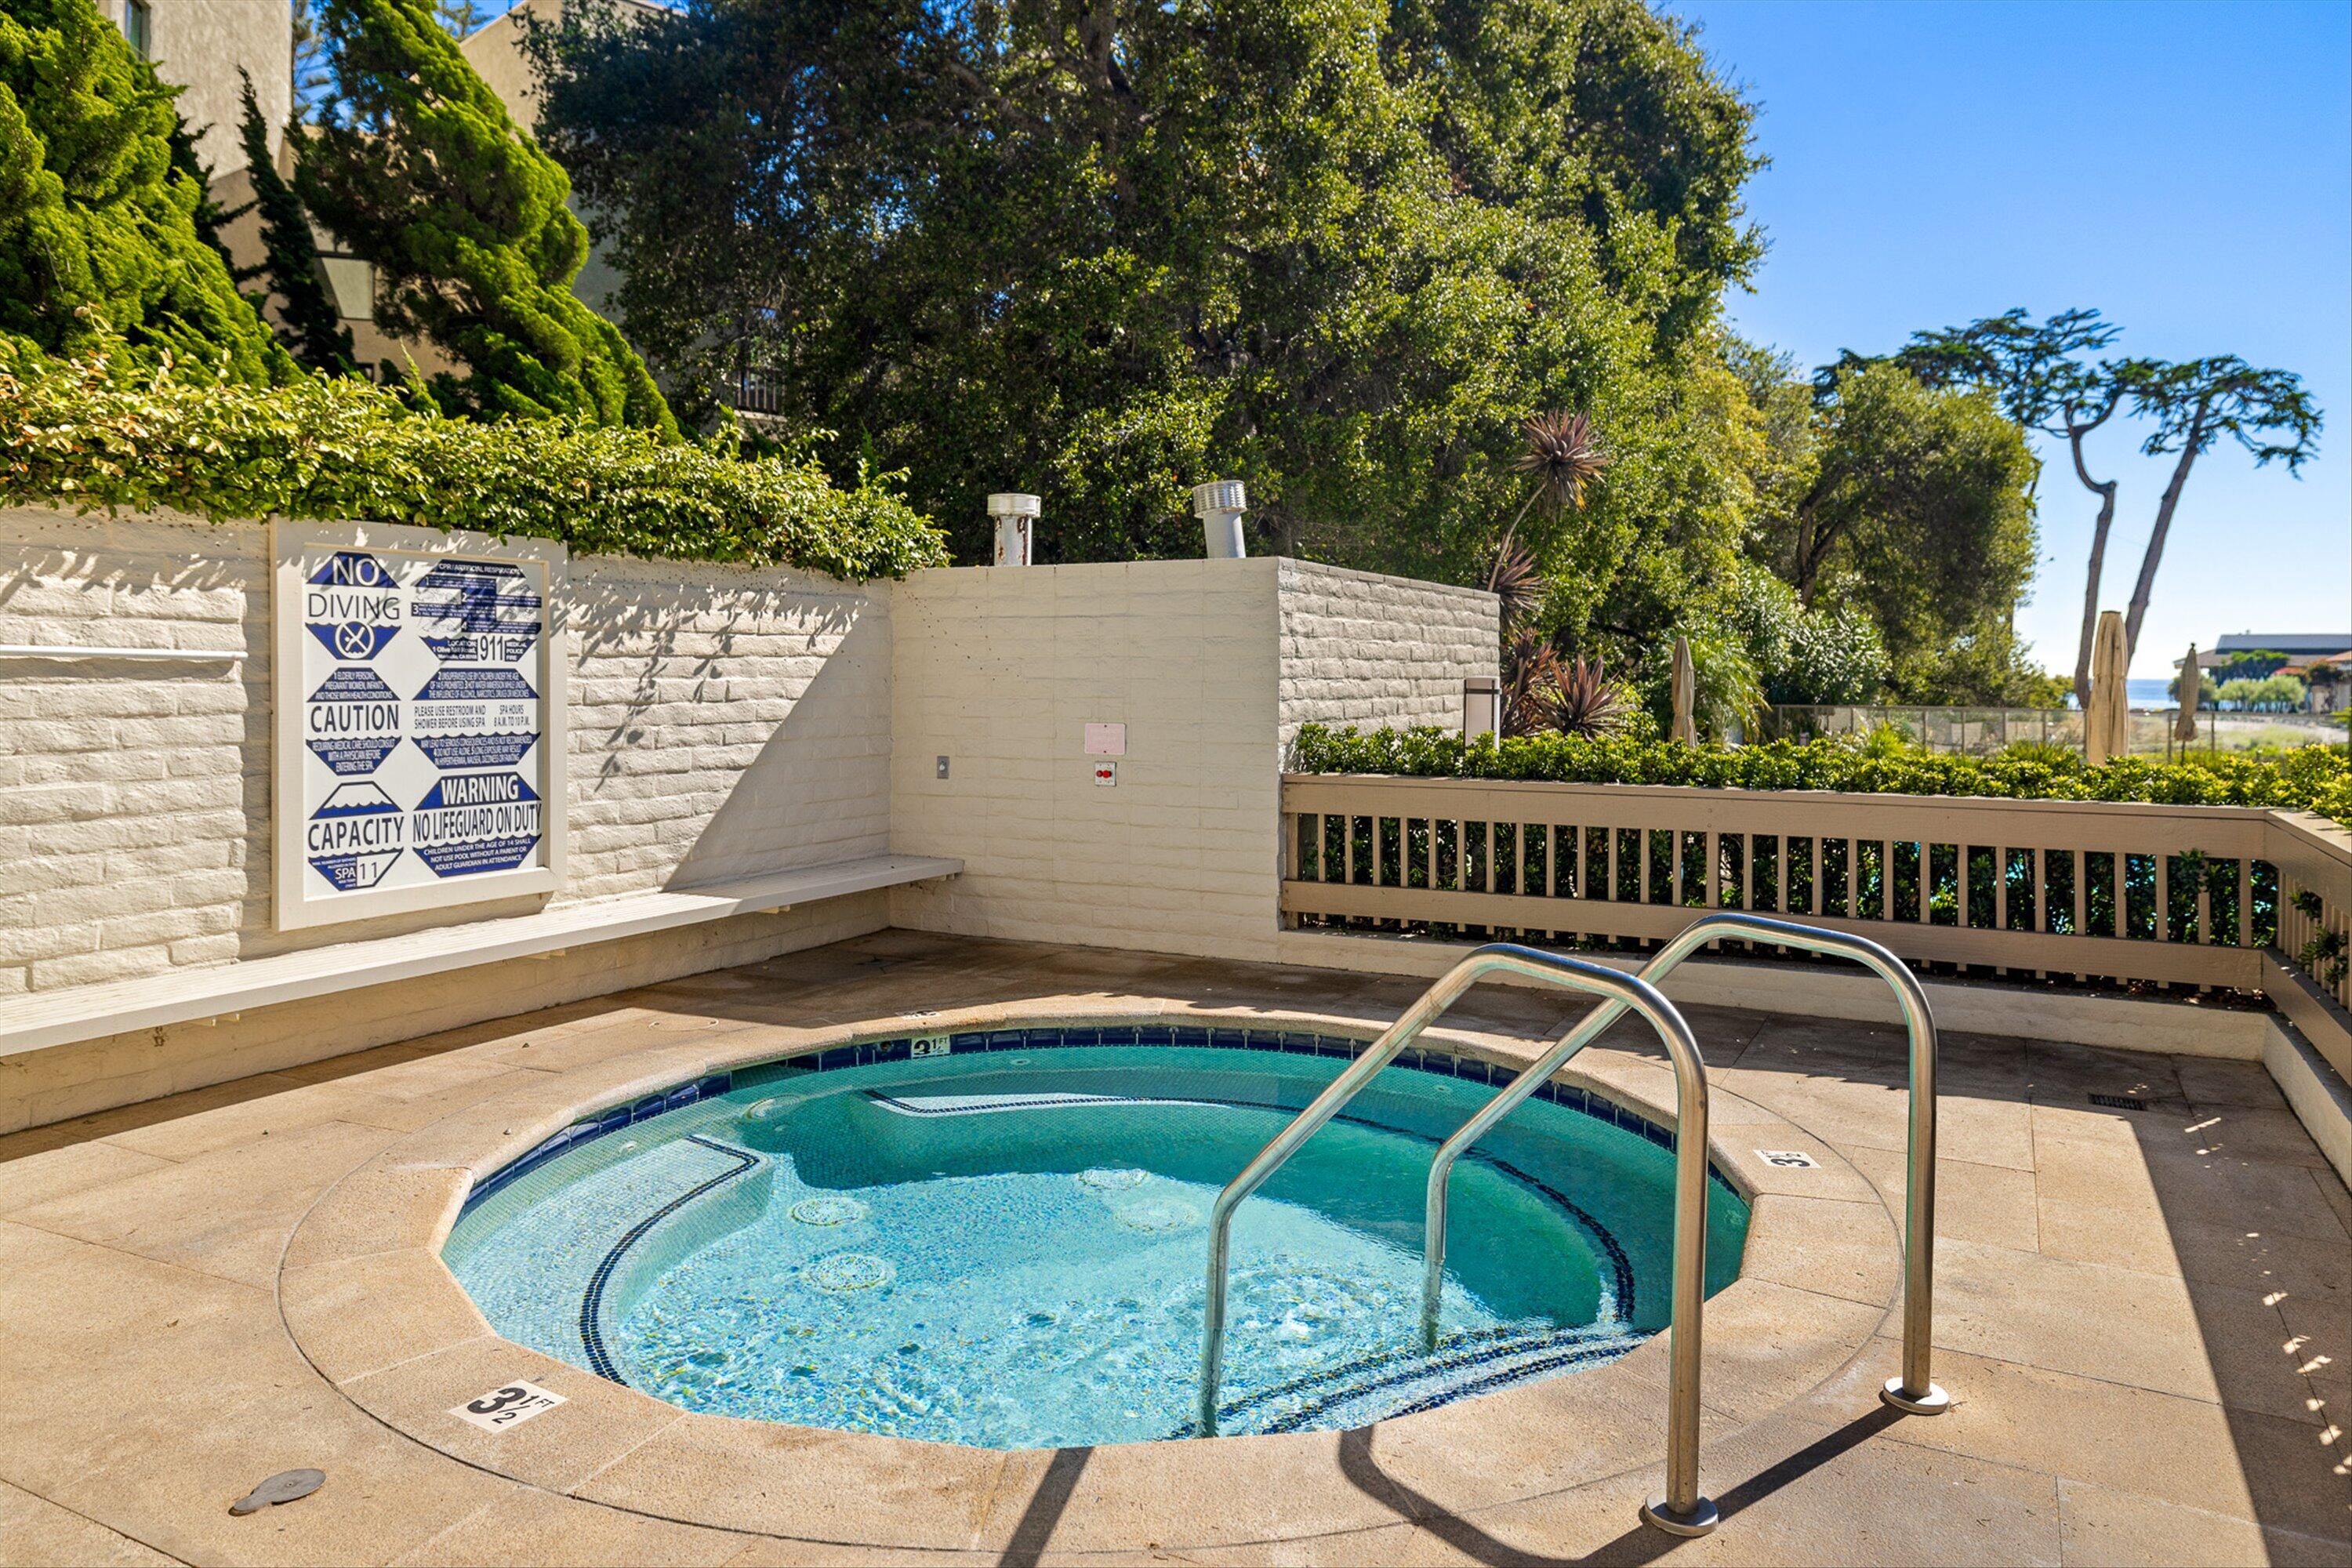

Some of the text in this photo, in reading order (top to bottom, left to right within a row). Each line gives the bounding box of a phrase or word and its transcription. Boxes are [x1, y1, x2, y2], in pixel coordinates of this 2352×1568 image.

[333, 557, 379, 586] NO
[309, 593, 399, 619] DIVING
[481, 636, 503, 660] 911
[310, 704, 398, 732] CAUTION
[415, 705, 486, 717] PLEASE USE RESTROOM AND
[499, 705, 524, 715] SPA HOURS
[508, 717, 514, 726] TO
[415, 717, 485, 729] SHOWER BEFORE USING SPA
[441, 775, 518, 804] WARNING
[308, 816, 405, 851] CAPACITY
[413, 804, 542, 842] NO LIFEGUARD ON DUTY
[424, 847, 453, 855] CHILDREN
[455, 844, 474, 852] UNDER
[336, 867, 355, 879] SPA
[453, 859, 482, 868] GUARDIAN
[467, 1388, 527, 1414] 3
[535, 1399, 554, 1407] FT
